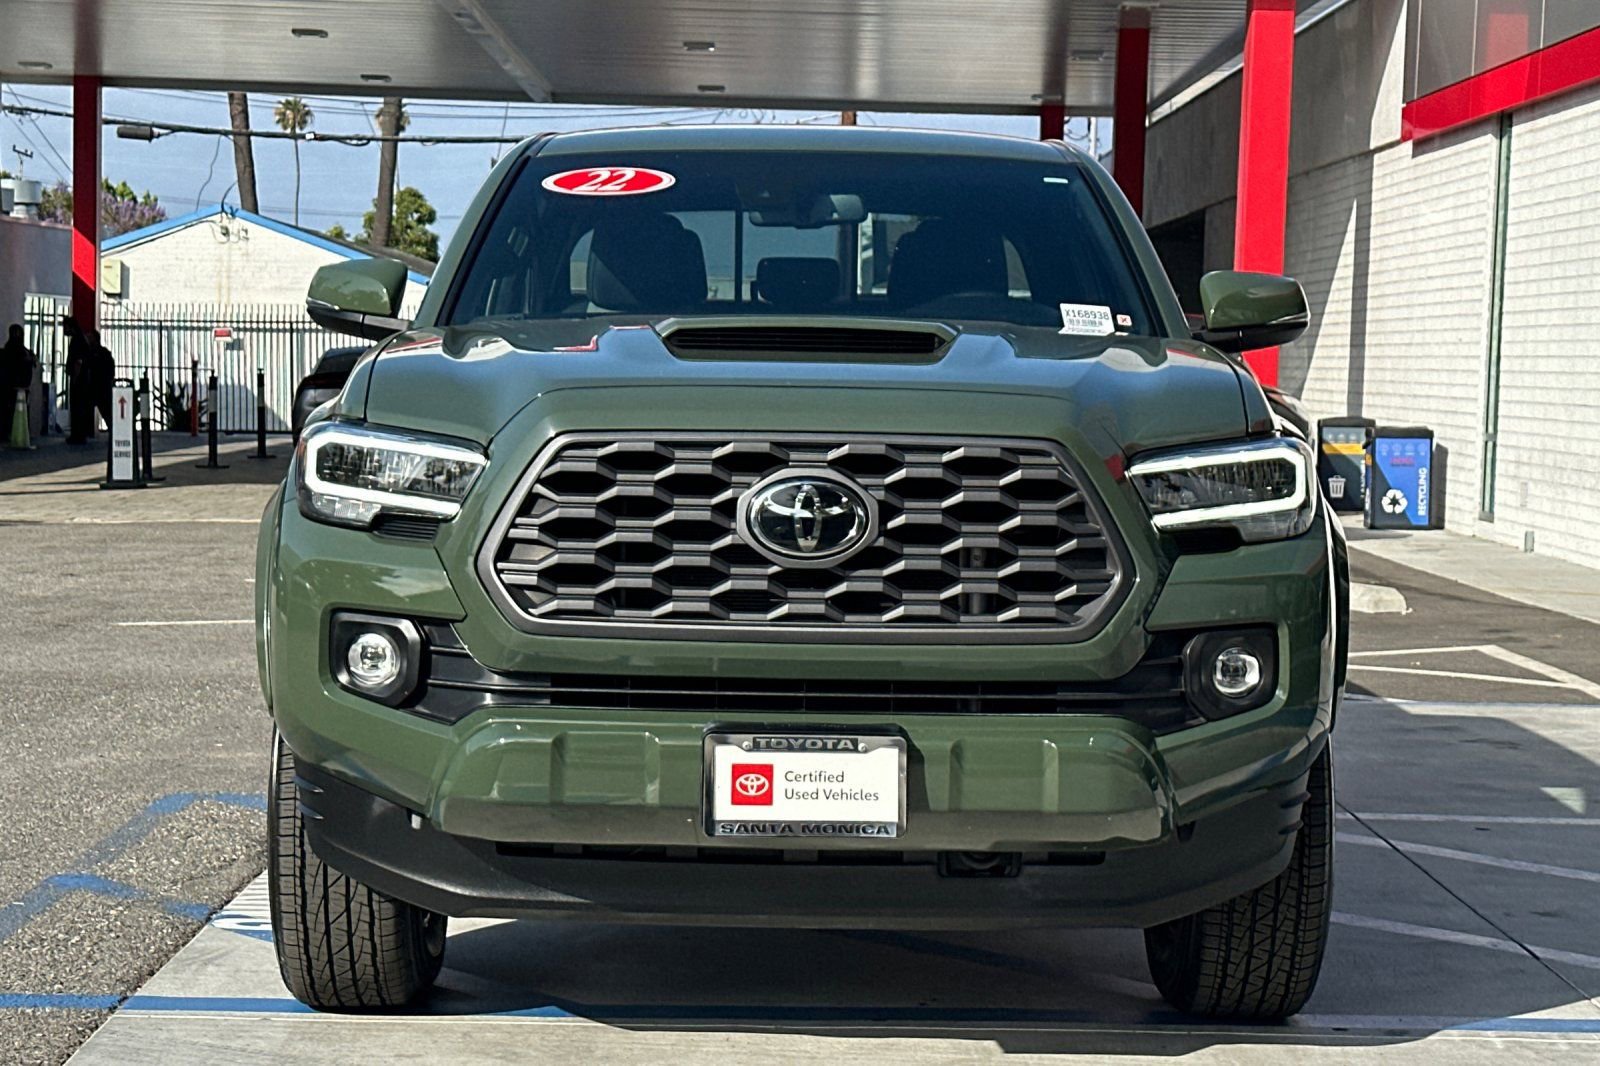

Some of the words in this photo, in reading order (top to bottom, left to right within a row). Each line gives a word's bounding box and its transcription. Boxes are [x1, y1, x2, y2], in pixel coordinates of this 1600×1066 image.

[571, 169, 636, 191] 22
[1065, 308, 1110, 320] X168938
[1417, 467, 1428, 516] RECYCLING
[755, 738, 855, 750] TOYOTA
[784, 770, 845, 783] Certified
[784, 788, 819, 800] Used
[823, 788, 880, 801] Vehicles
[720, 822, 794, 834] SANTA
[801, 823, 891, 835] MONICA
